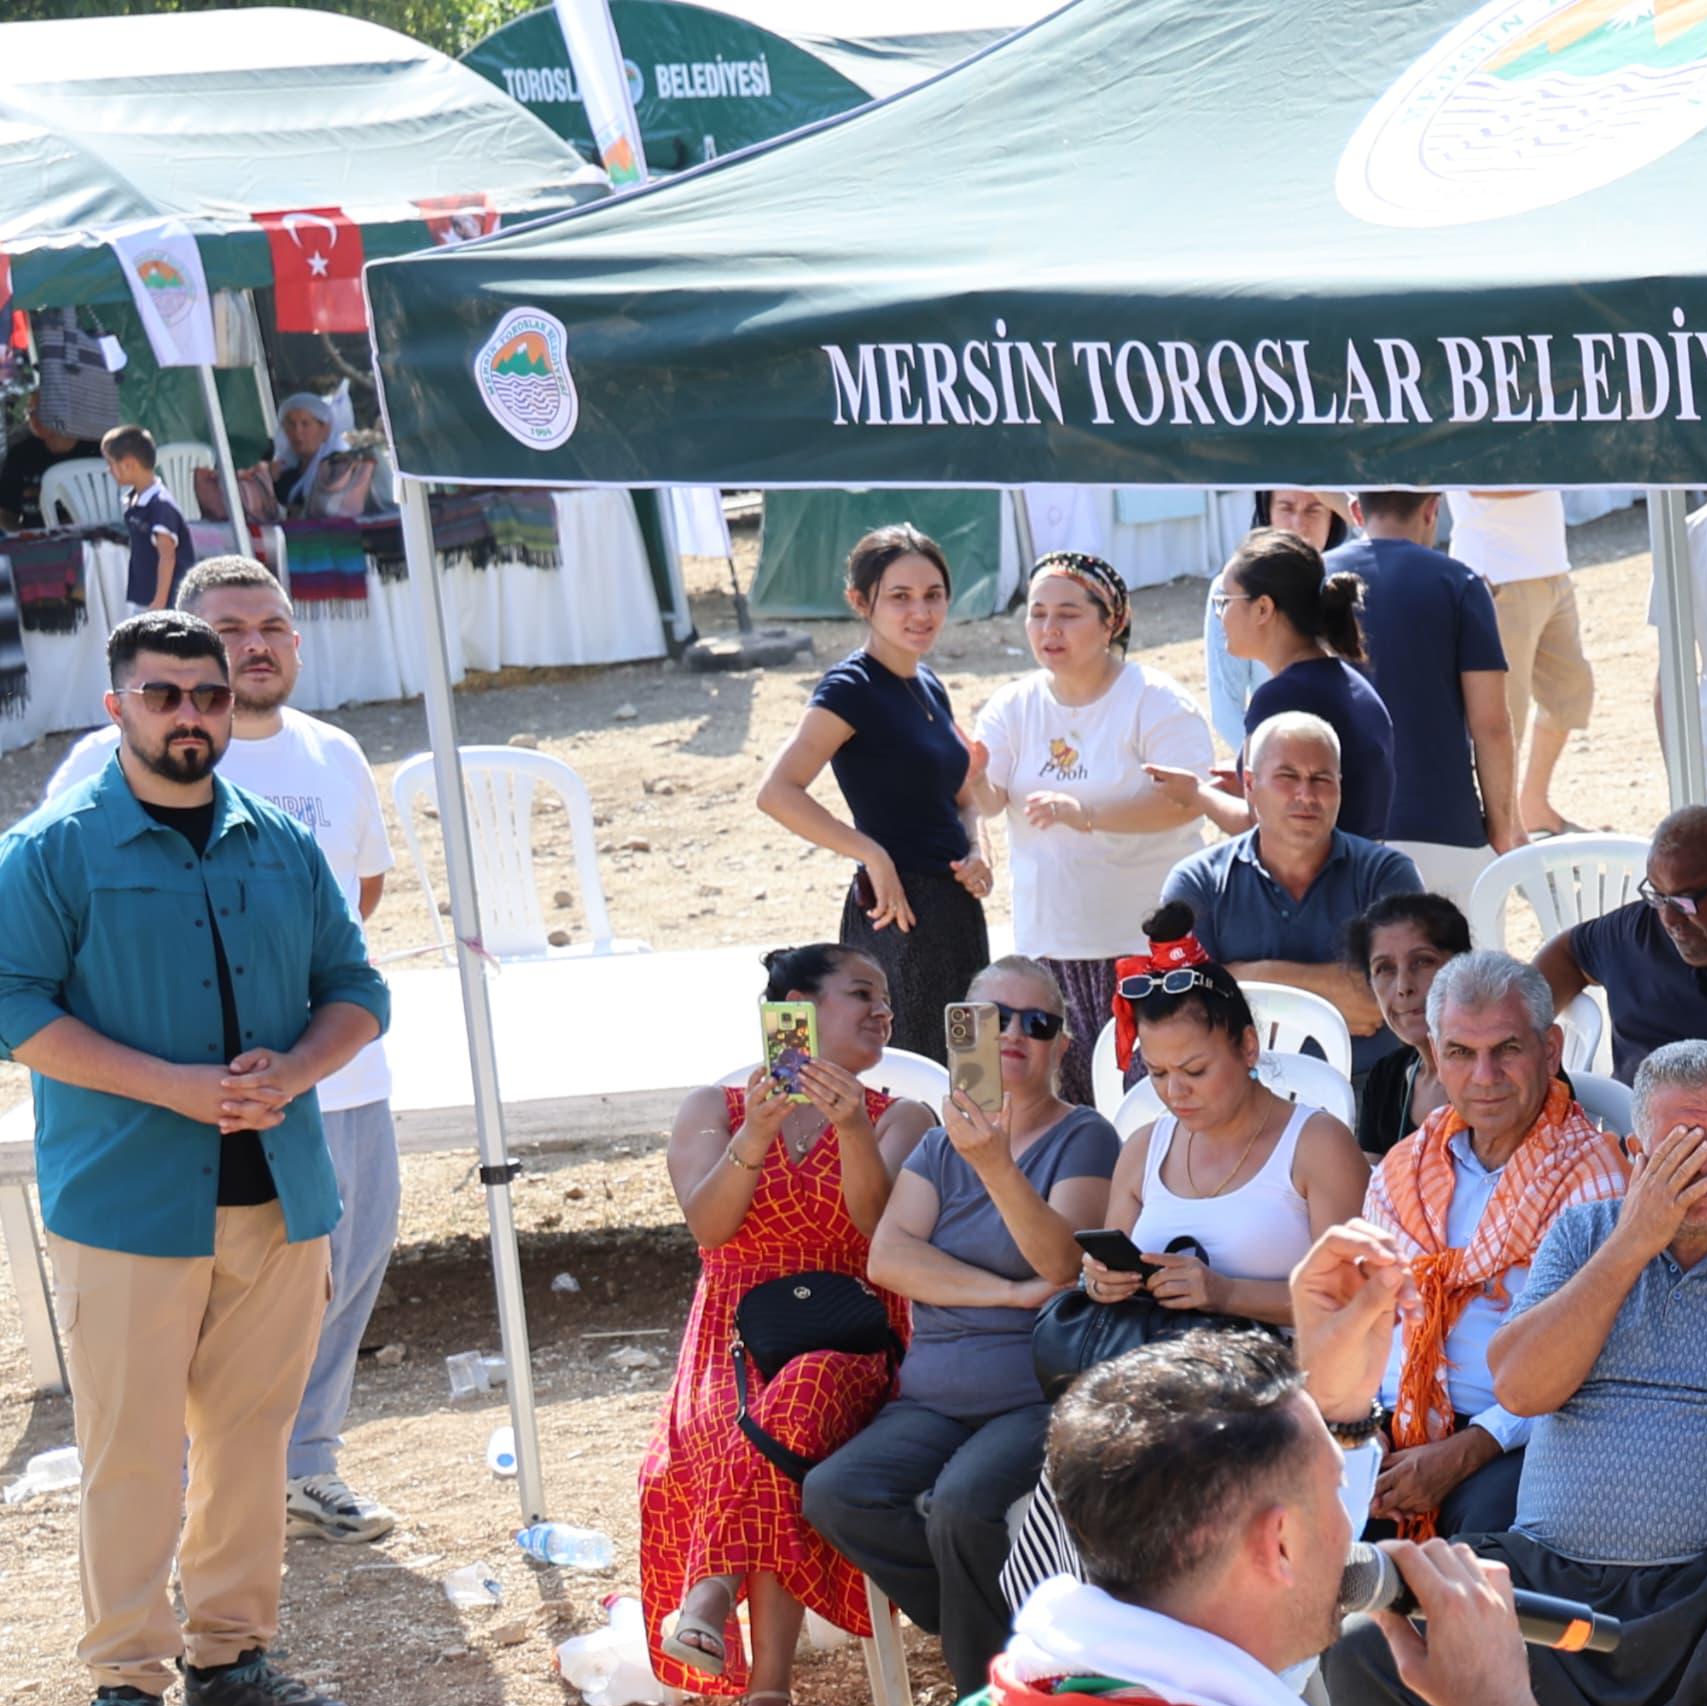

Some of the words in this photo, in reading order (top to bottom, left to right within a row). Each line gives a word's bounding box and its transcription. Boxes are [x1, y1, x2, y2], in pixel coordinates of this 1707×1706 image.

[502, 67, 582, 103] TOROSL
[654, 53, 772, 99] BELEDİYESİ
[822, 318, 1063, 426] MERSİN
[1073, 338, 1432, 426] TOROSLAR
[1038, 762, 1088, 781] Pooh
